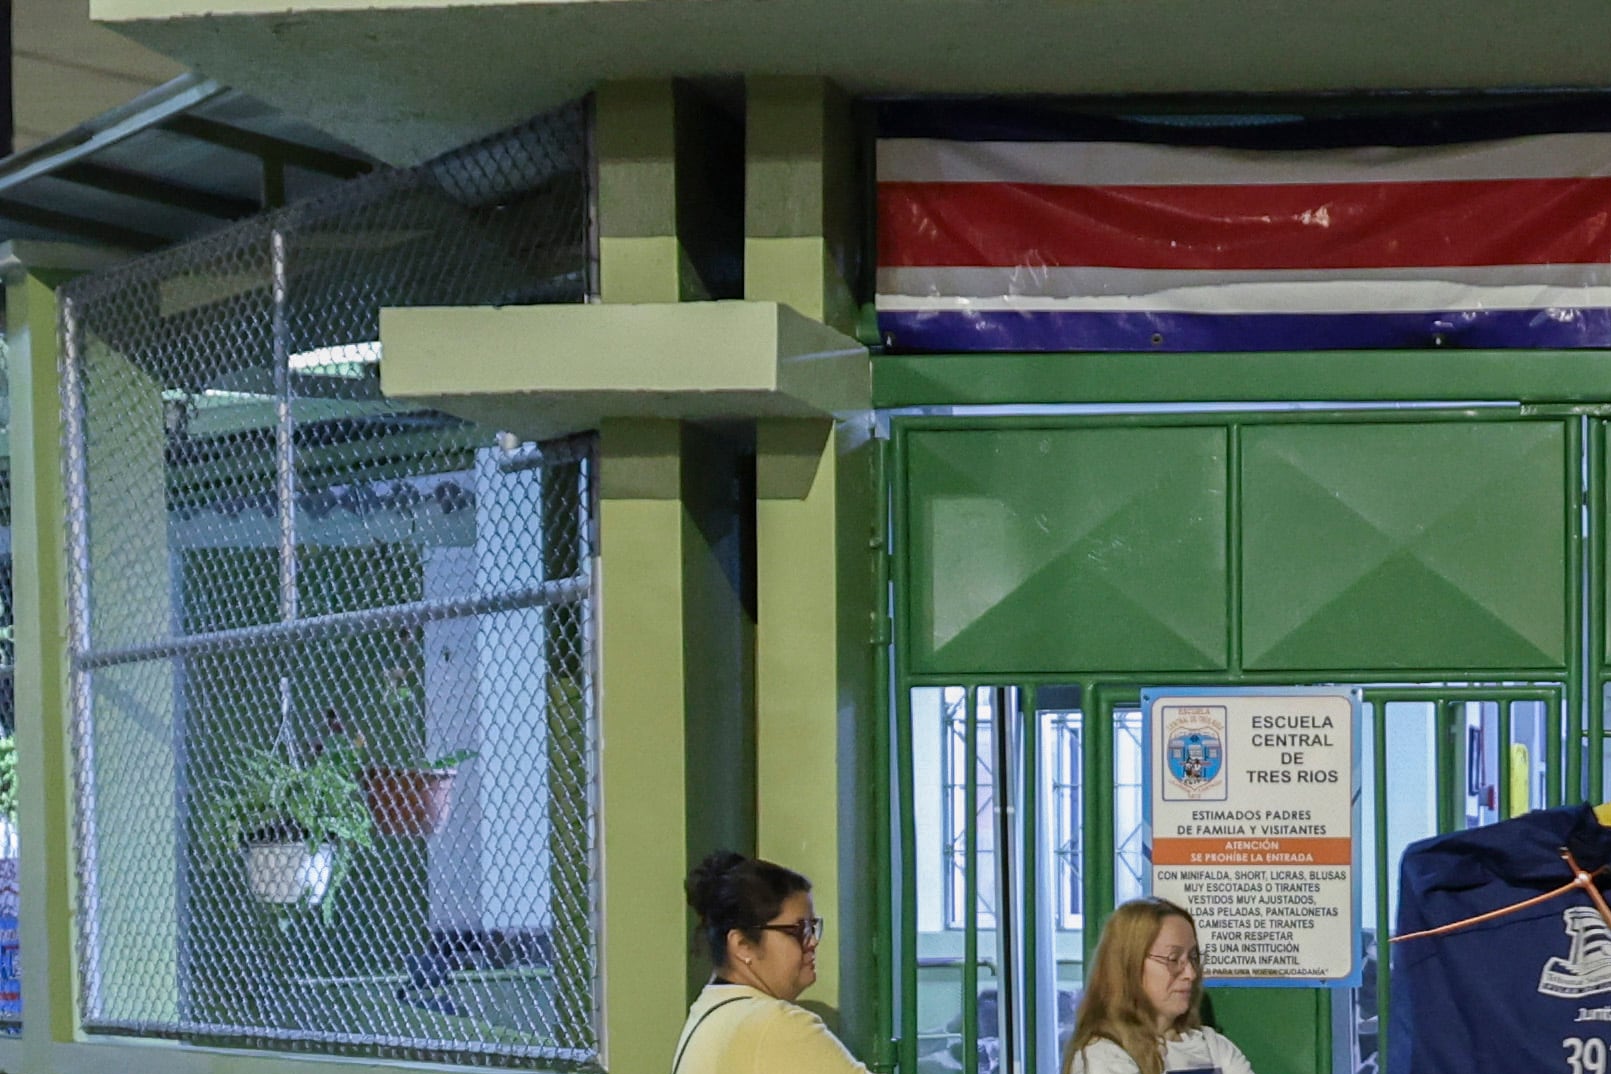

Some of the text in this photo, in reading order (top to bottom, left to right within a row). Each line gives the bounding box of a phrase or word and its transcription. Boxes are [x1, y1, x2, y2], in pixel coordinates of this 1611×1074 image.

[1251, 715, 1334, 729] ESCUELA
[1251, 733, 1334, 747] CENTRAL
[1281, 752, 1304, 765] DE
[1246, 770, 1339, 783] TRES RIOS
[1192, 810, 1311, 821] ESTIMADOS PADRES
[1177, 825, 1327, 835] DE FAMILIA Y VISITANTES
[1225, 839, 1279, 850] ATENCIÓN
[1190, 853, 1202, 862] SE
[1250, 853, 1263, 862] LA
[1266, 853, 1313, 862] ENTRADA
[1157, 871, 1347, 881] CON MINIFALDA, SHORT, LICRAS, BLUSAS
[1184, 883, 1321, 893] MUY ESCOTADAS O TIRANTES
[1188, 895, 1317, 905] VESTIDOS MUY AJUSTADOS,
[1186, 907, 1339, 918] LDAS PELADAS, PANTALONETAS
[1198, 919, 1314, 929] CAMISETAS DE TIRANTES
[1211, 931, 1293, 941] FAVOR RESPETAR
[1205, 942, 1300, 953] ES UNA INSTITUCIÓN
[1205, 955, 1256, 965] EDUCATIVA
